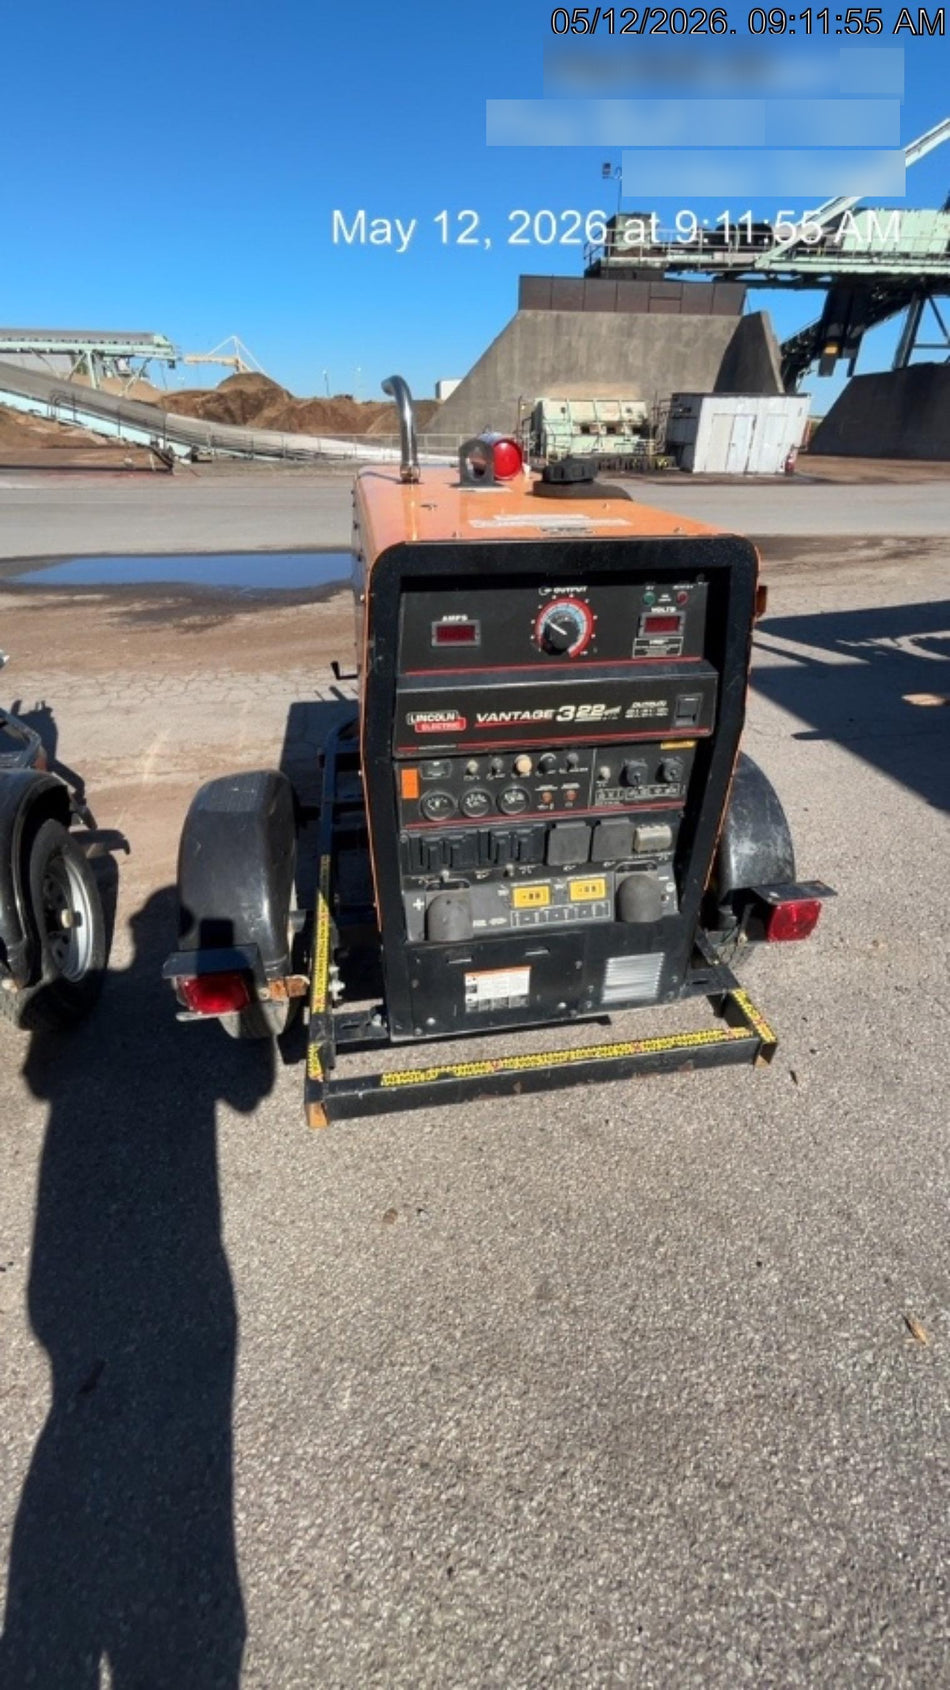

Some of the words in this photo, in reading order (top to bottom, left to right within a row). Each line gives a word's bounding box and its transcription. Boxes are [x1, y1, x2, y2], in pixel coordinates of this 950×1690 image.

[442, 614, 468, 622] AMPS
[410, 712, 456, 722] LINCOLN
[476, 709, 555, 723] VANTAGE
[556, 703, 606, 722] 322
